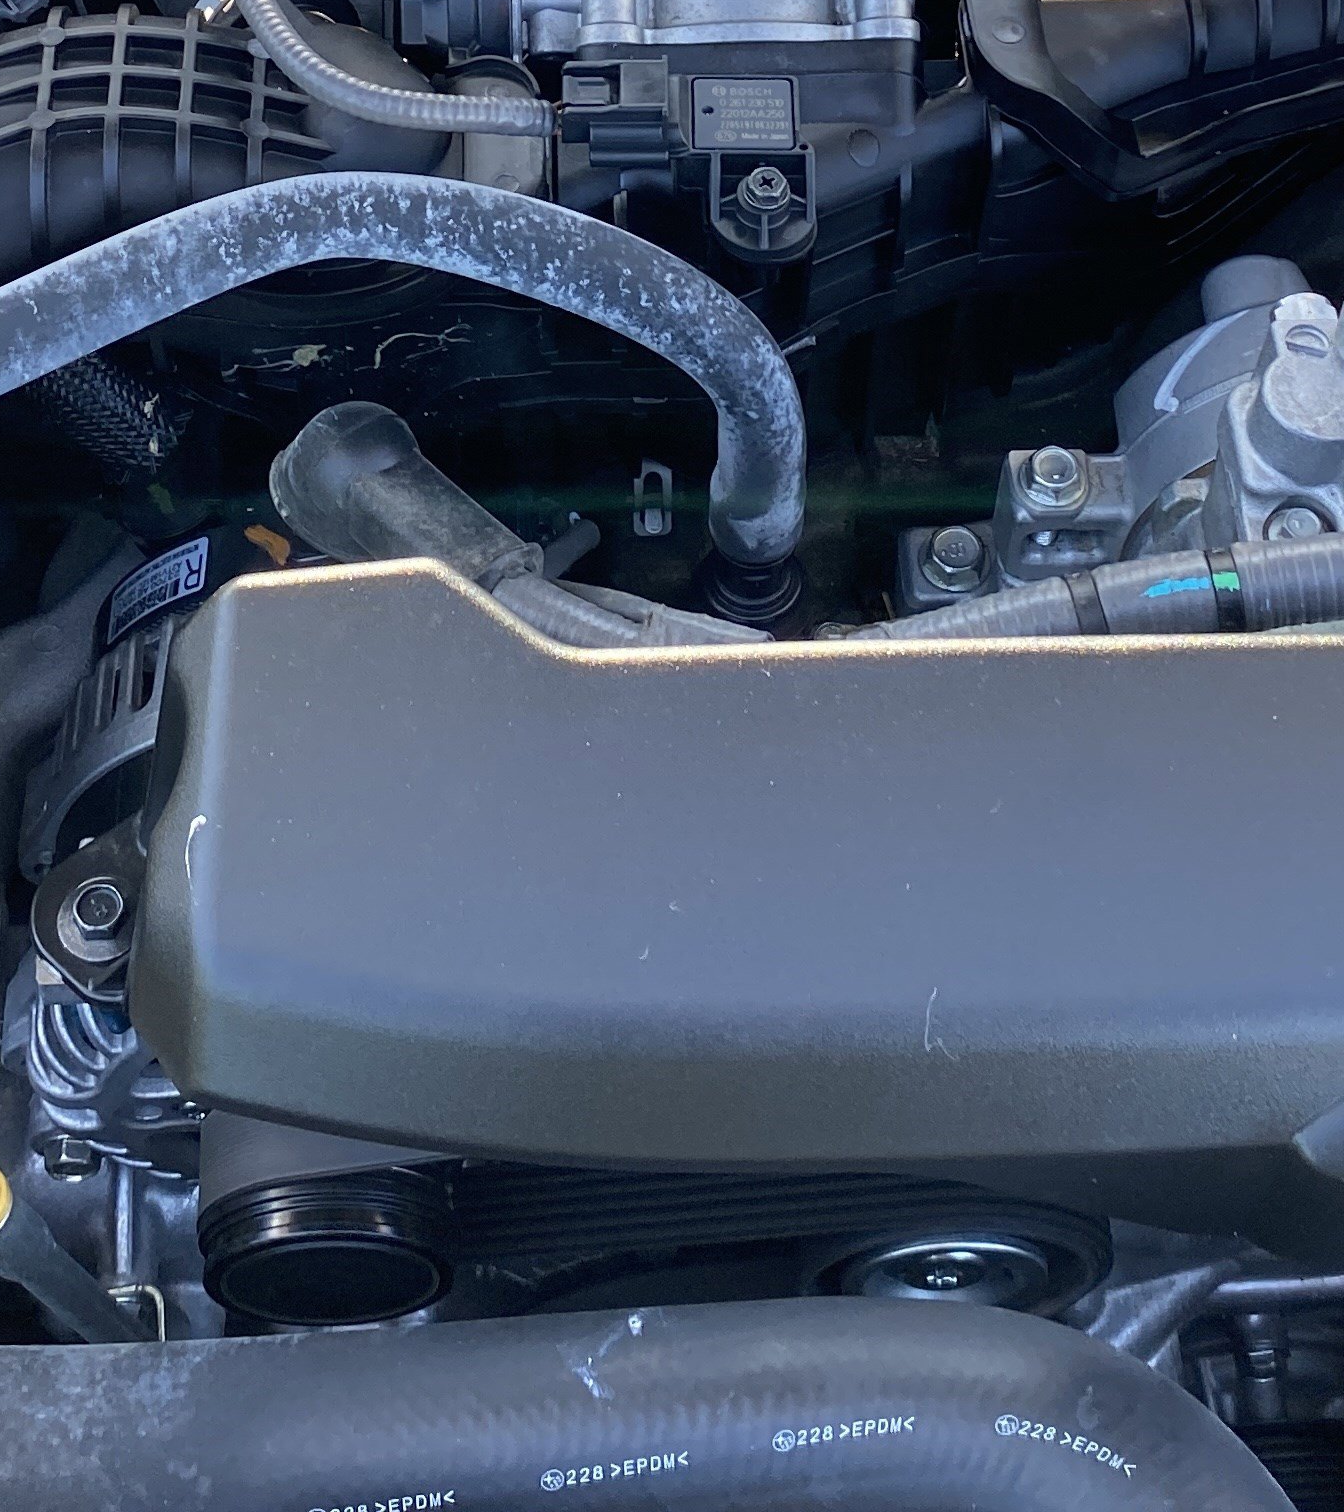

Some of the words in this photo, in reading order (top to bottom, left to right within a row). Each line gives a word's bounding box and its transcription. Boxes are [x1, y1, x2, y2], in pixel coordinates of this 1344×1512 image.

[729, 87, 772, 96] BOSCH
[184, 553, 203, 590] R
[796, 1425, 834, 1446] 228
[1017, 1420, 1056, 1442] 228
[566, 1465, 605, 1486] 228
